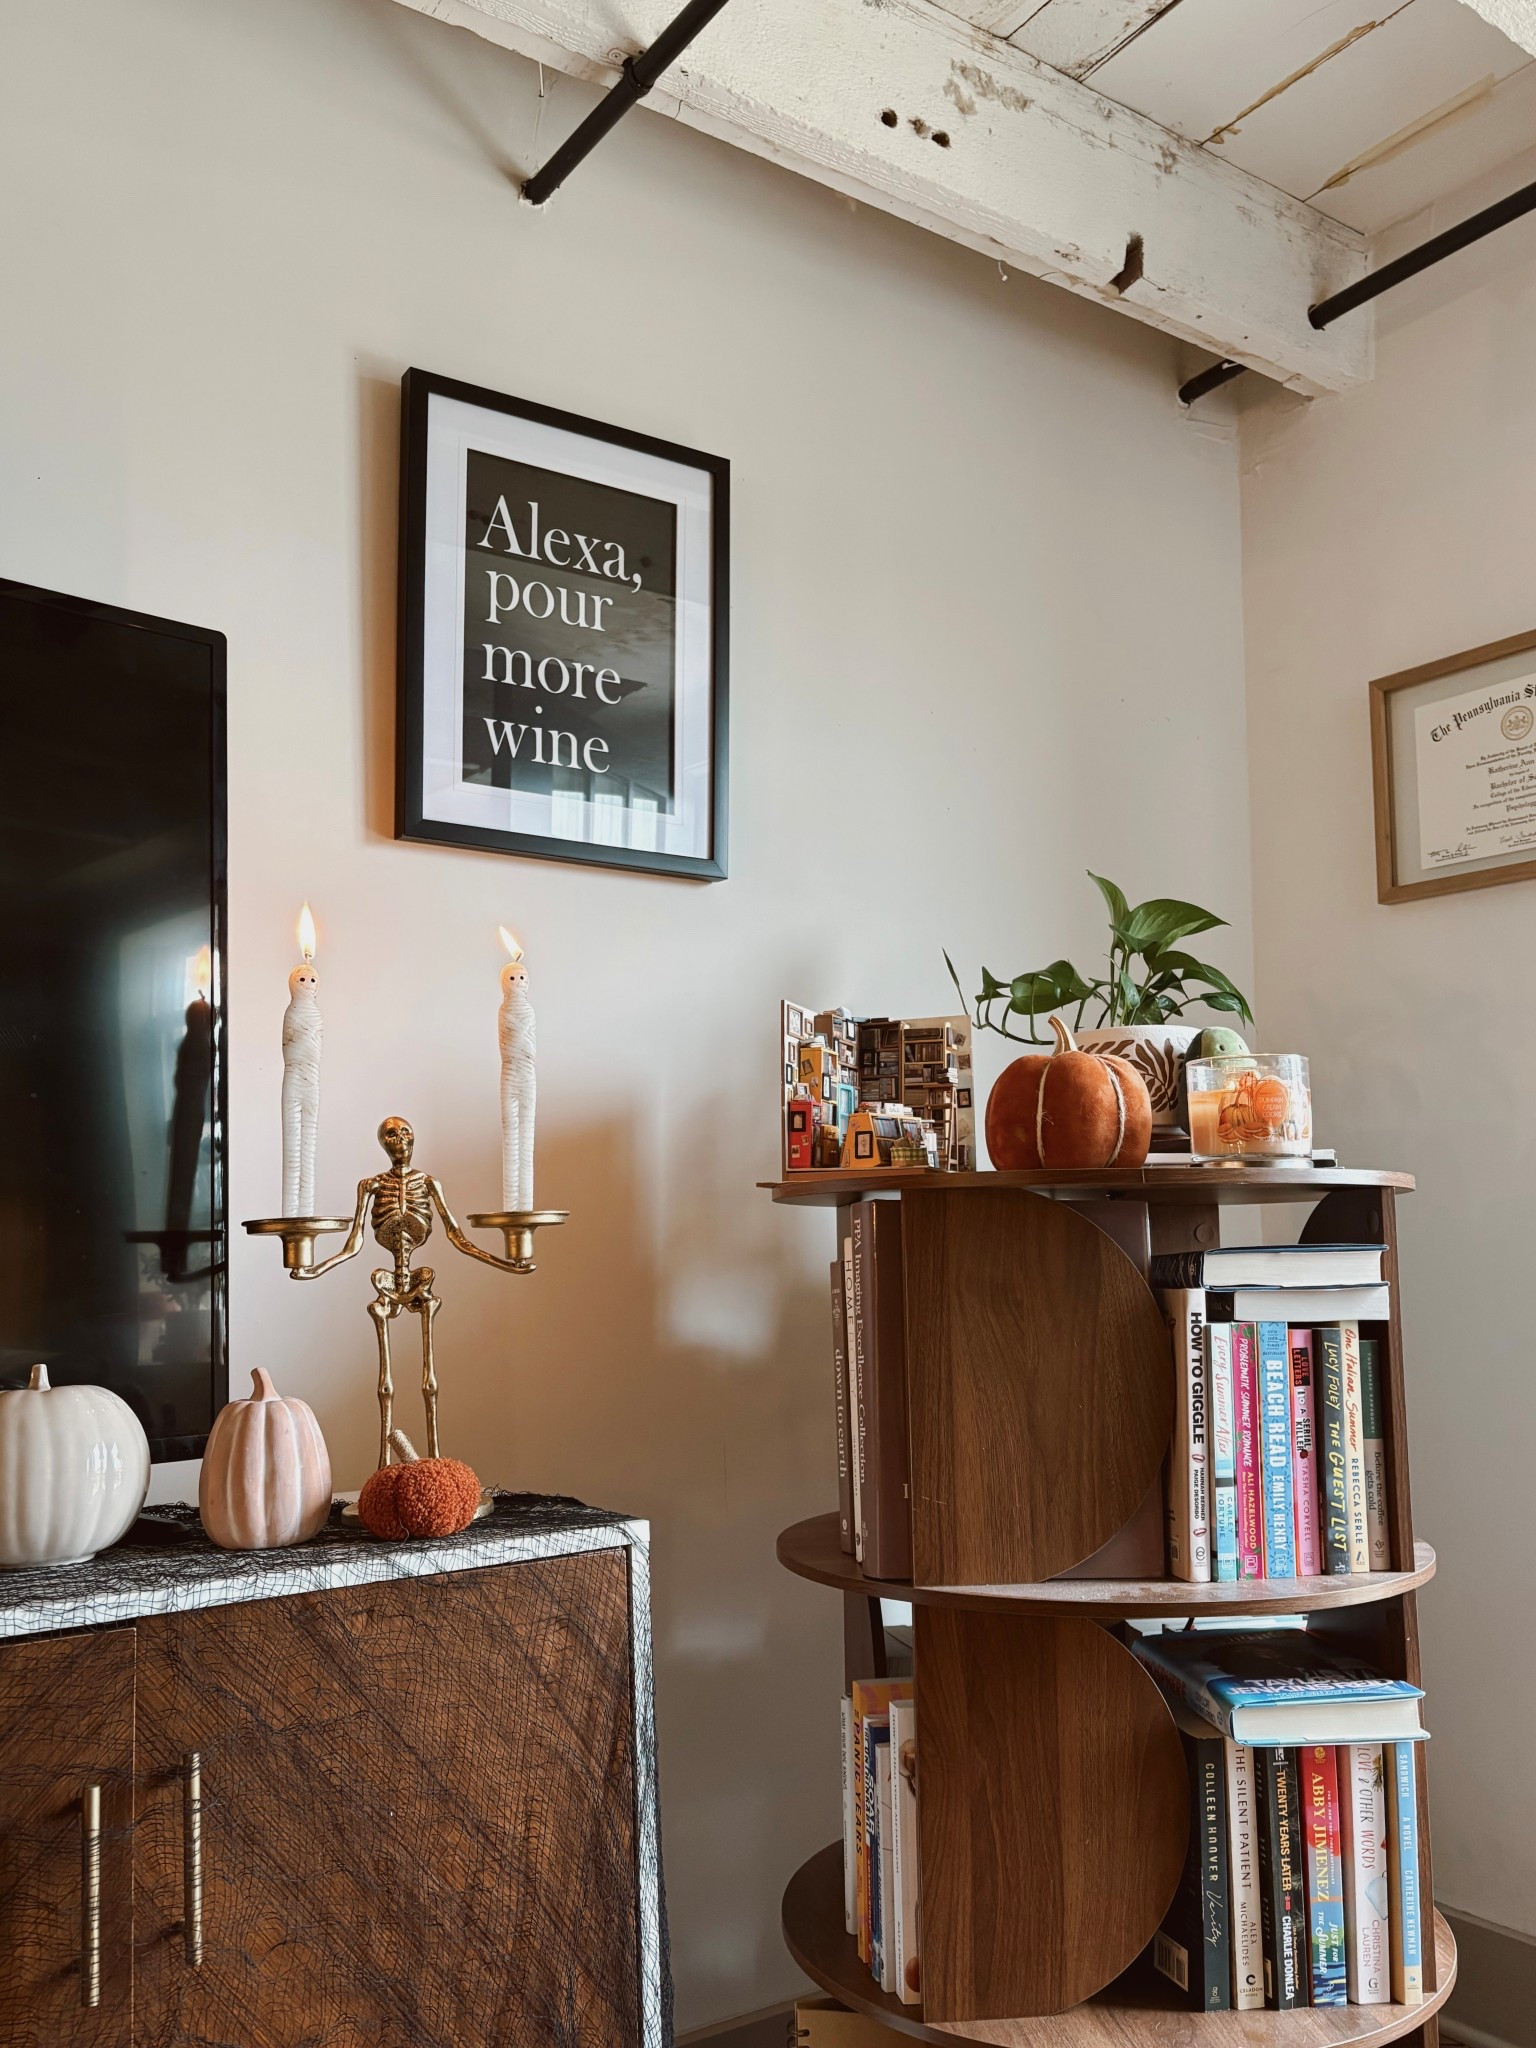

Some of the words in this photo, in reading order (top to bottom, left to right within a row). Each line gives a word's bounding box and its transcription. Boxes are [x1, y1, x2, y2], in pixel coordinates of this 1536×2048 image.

[477, 494, 643, 594] Alexa,
[485, 567, 614, 633] pour
[481, 642, 622, 706] more
[1430, 723, 1451, 743] The
[1452, 690, 1520, 731] Pennsylvania
[483, 705, 611, 774] wine
[854, 1218, 862, 1250] PPA
[854, 1254, 863, 1316] Imaging
[1191, 1312, 1203, 1352] HOW
[1345, 1328, 1357, 1350] One
[835, 1348, 845, 1400] down
[856, 1318, 865, 1400] Excellence
[1192, 1355, 1204, 1378] TO
[1213, 1336, 1228, 1373] Every
[1238, 1338, 1249, 1390] PROBLEMATIC
[1293, 1350, 1302, 1385] LETTERS
[1301, 1356, 1310, 1377] LOVE
[1324, 1342, 1339, 1372] LUCY
[1266, 1360, 1285, 1416] BEACH
[1325, 1374, 1340, 1410] FOLEY
[1345, 1352, 1357, 1398] Italian
[837, 1405, 846, 1424] to
[1192, 1382, 1204, 1444] GIGGLE
[1215, 1373, 1230, 1426] Summer
[1240, 1390, 1251, 1428] SUMMER
[1216, 1425, 1232, 1458] After
[1268, 1422, 1286, 1468] READ
[1303, 1418, 1312, 1448] SERIAL
[1329, 1421, 1341, 1448] THE
[1345, 1400, 1359, 1452] Summer
[839, 1428, 847, 1478] earth
[1242, 1430, 1253, 1468] ROMANCE
[1247, 1472, 1255, 1487] ALI
[1272, 1475, 1286, 1510] EMILY
[1328, 1451, 1345, 1513] GUEST
[1351, 1458, 1361, 1507] REBECCA
[1365, 1470, 1374, 1489] gets
[1248, 1490, 1257, 1550] HAZELWOOD
[1368, 1491, 1376, 1510] cold
[1377, 1500, 1385, 1526] coffee
[1274, 1513, 1287, 1550] HENRY
[1331, 1516, 1347, 1552] LIST
[1354, 1512, 1364, 1544] SERLE
[1226, 1684, 1336, 1695] JENKINS
[1338, 1679, 1394, 1689] REID
[1236, 1747, 1246, 1772] THE
[1357, 1748, 1372, 1772] LOVE
[1400, 1754, 1410, 1798] SANDWICH
[1205, 1763, 1216, 1821] COLLEEN
[1237, 1779, 1248, 1826] SILENT
[1276, 1770, 1288, 1816] TWENTY
[1311, 1772, 1326, 1820] ABBY
[1359, 1789, 1374, 1823] OTHER
[1208, 1827, 1218, 1881] HOOVER
[1280, 1819, 1290, 1856] YEARS
[1360, 1830, 1376, 1869] WORDS
[1403, 1824, 1412, 1850] NOVEL
[1240, 1833, 1252, 1890] PATIENT
[1281, 1858, 1292, 1892] LATER
[1312, 1823, 1329, 1902] JIMENEZ
[1405, 1870, 1415, 1916] CATHERINE
[1205, 1890, 1223, 1948] Verity
[1240, 1902, 1249, 1967] MICHAELIDES
[1282, 1916, 1293, 1958] CHARLIE
[1329, 1921, 1339, 1947] JUST
[1406, 1919, 1416, 1955] NEWMAN
[1316, 1926, 1329, 1974] SUMMER
[1362, 1927, 1370, 1967] LAUREN
[1372, 1919, 1381, 1974] CHRISTINA
[1284, 1959, 1295, 2000] DONLEA
